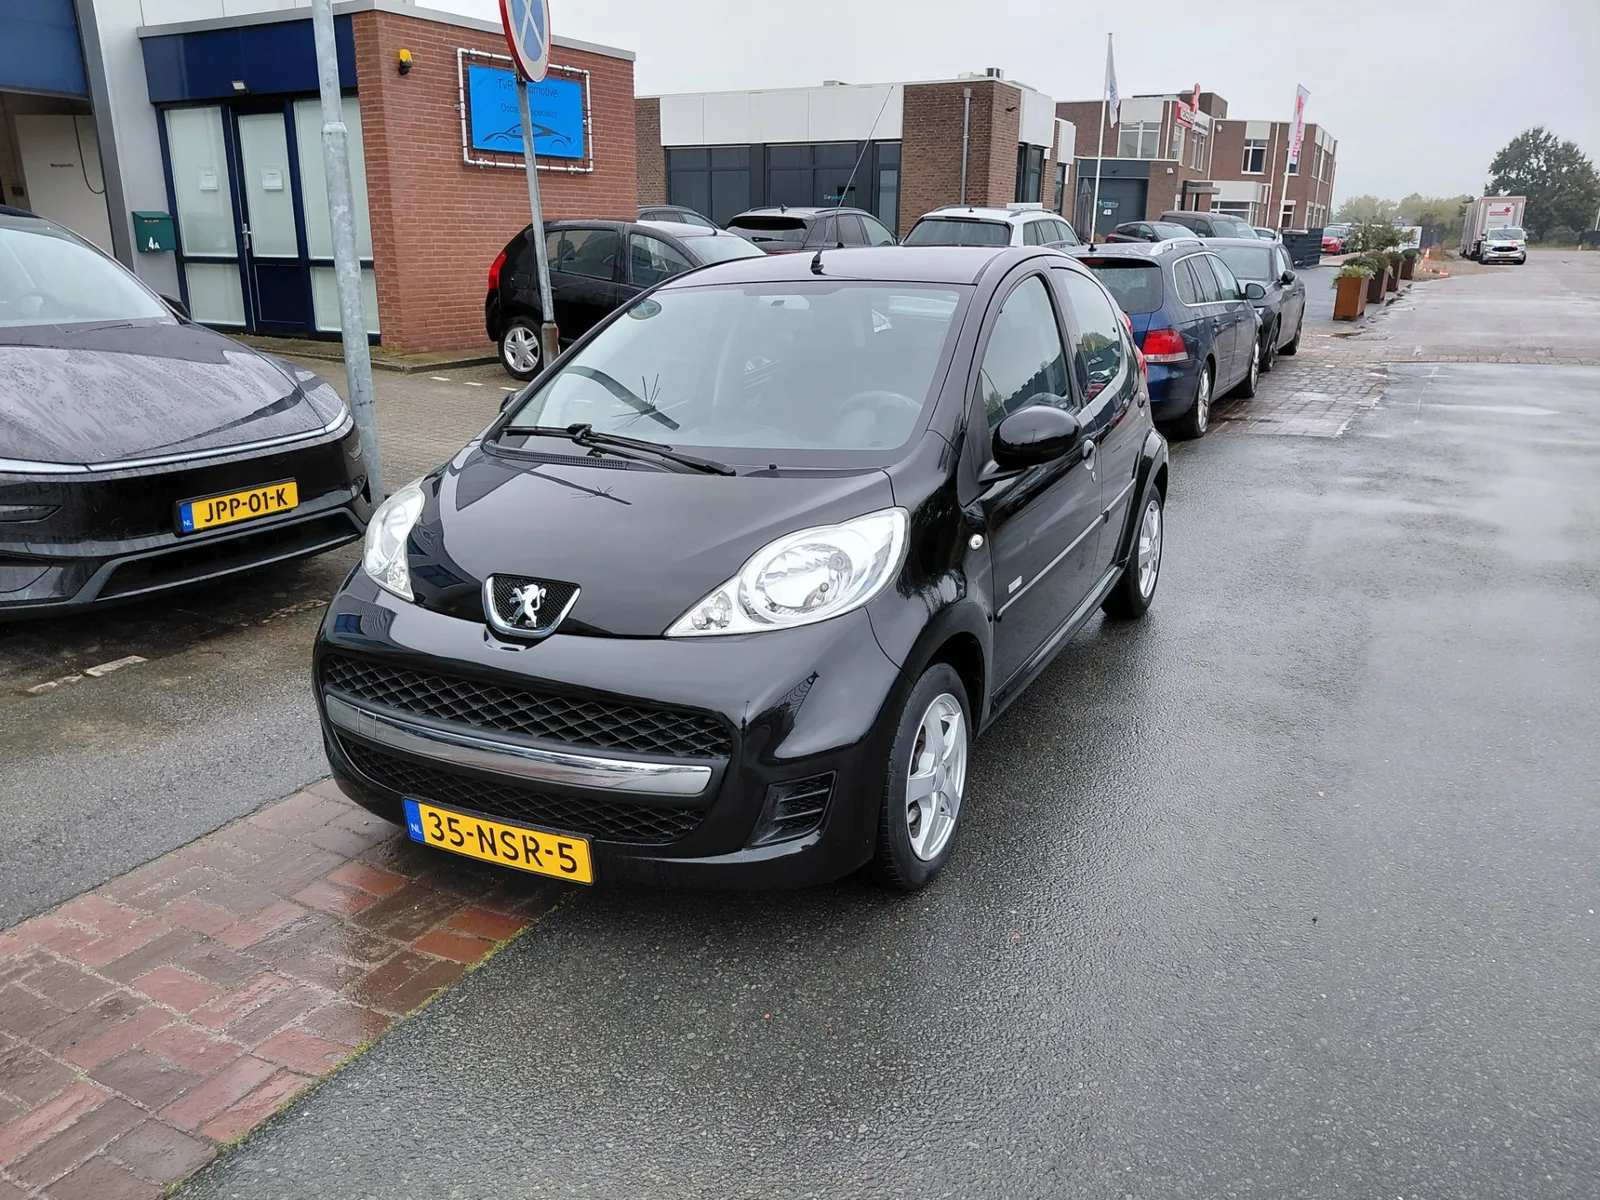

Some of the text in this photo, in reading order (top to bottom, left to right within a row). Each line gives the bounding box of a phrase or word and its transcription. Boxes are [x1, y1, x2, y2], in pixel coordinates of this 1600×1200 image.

[497, 78, 515, 91] TvR
[183, 488, 288, 527] NL JPP-01-K
[410, 812, 578, 873] NL 35-NSR-5
